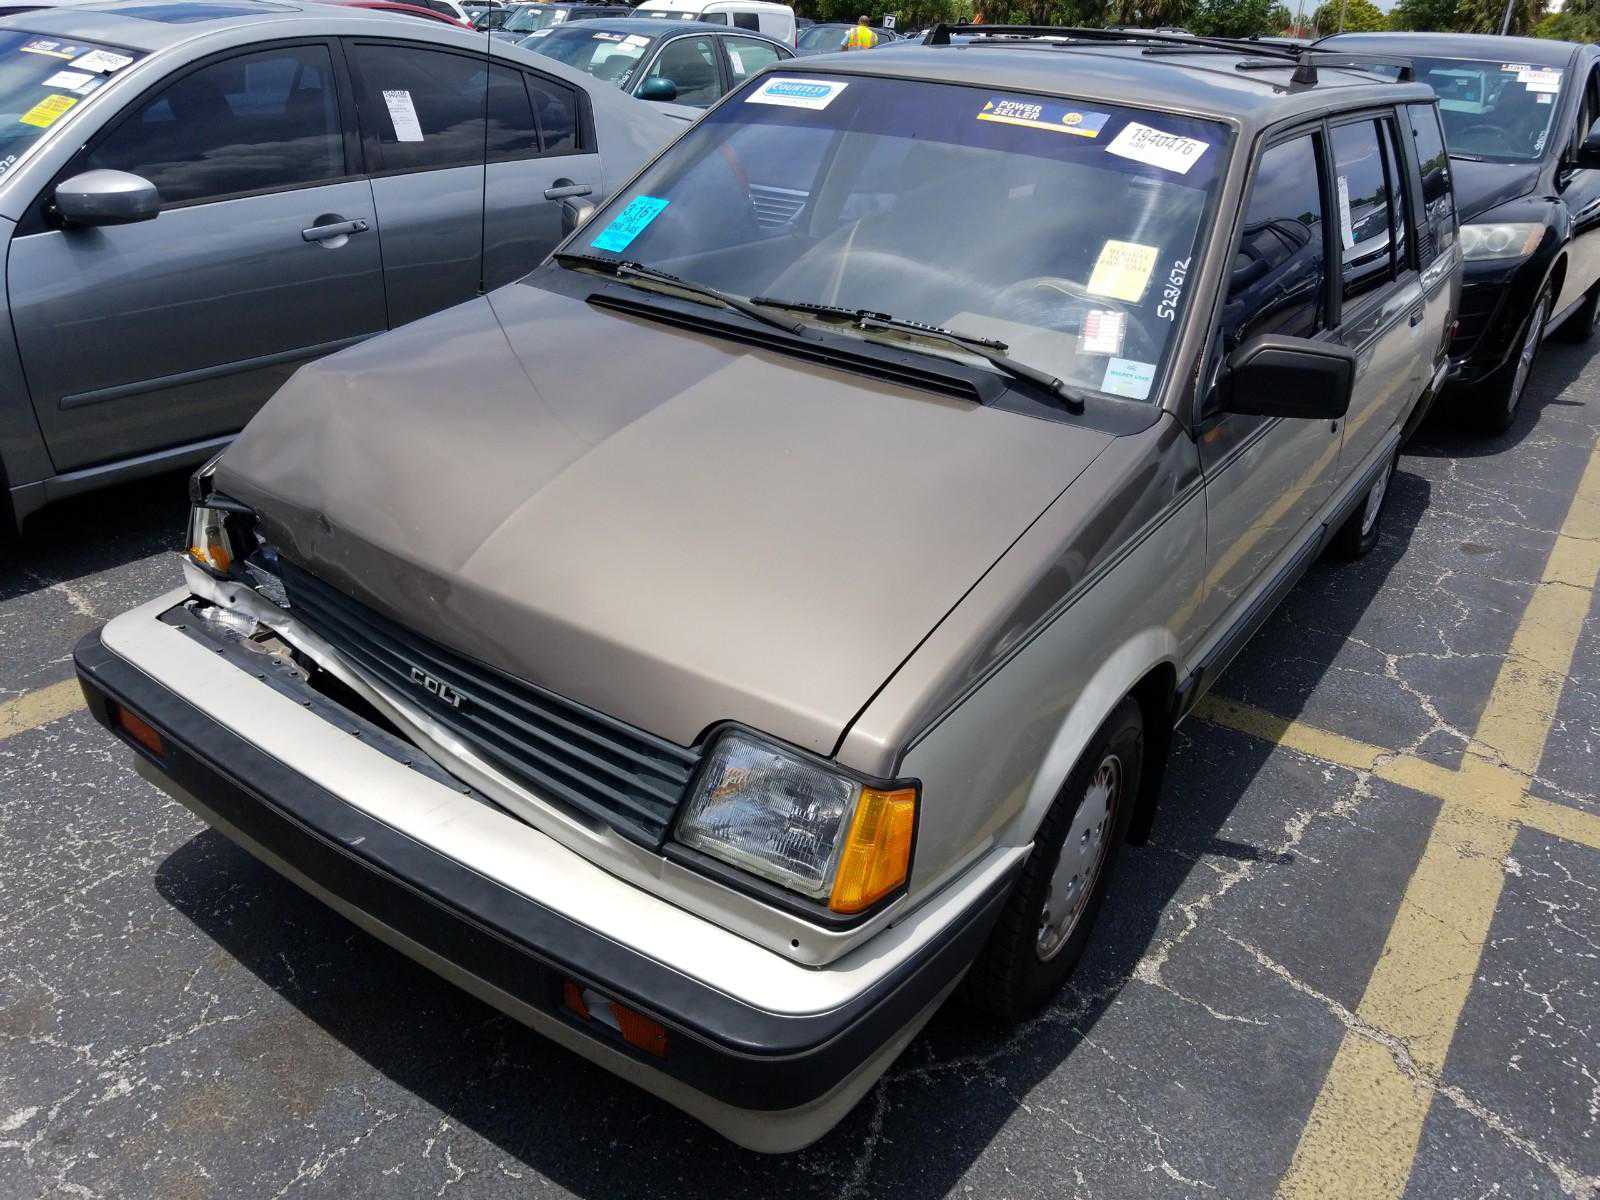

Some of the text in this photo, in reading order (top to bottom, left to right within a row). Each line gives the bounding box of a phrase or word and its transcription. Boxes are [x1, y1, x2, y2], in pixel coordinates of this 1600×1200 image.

[887, 18, 893, 26] 7
[998, 100, 1042, 113] POWER
[993, 107, 1040, 120] SELLER
[1131, 128, 1197, 156] 1940476
[410, 667, 467, 708] COLT
